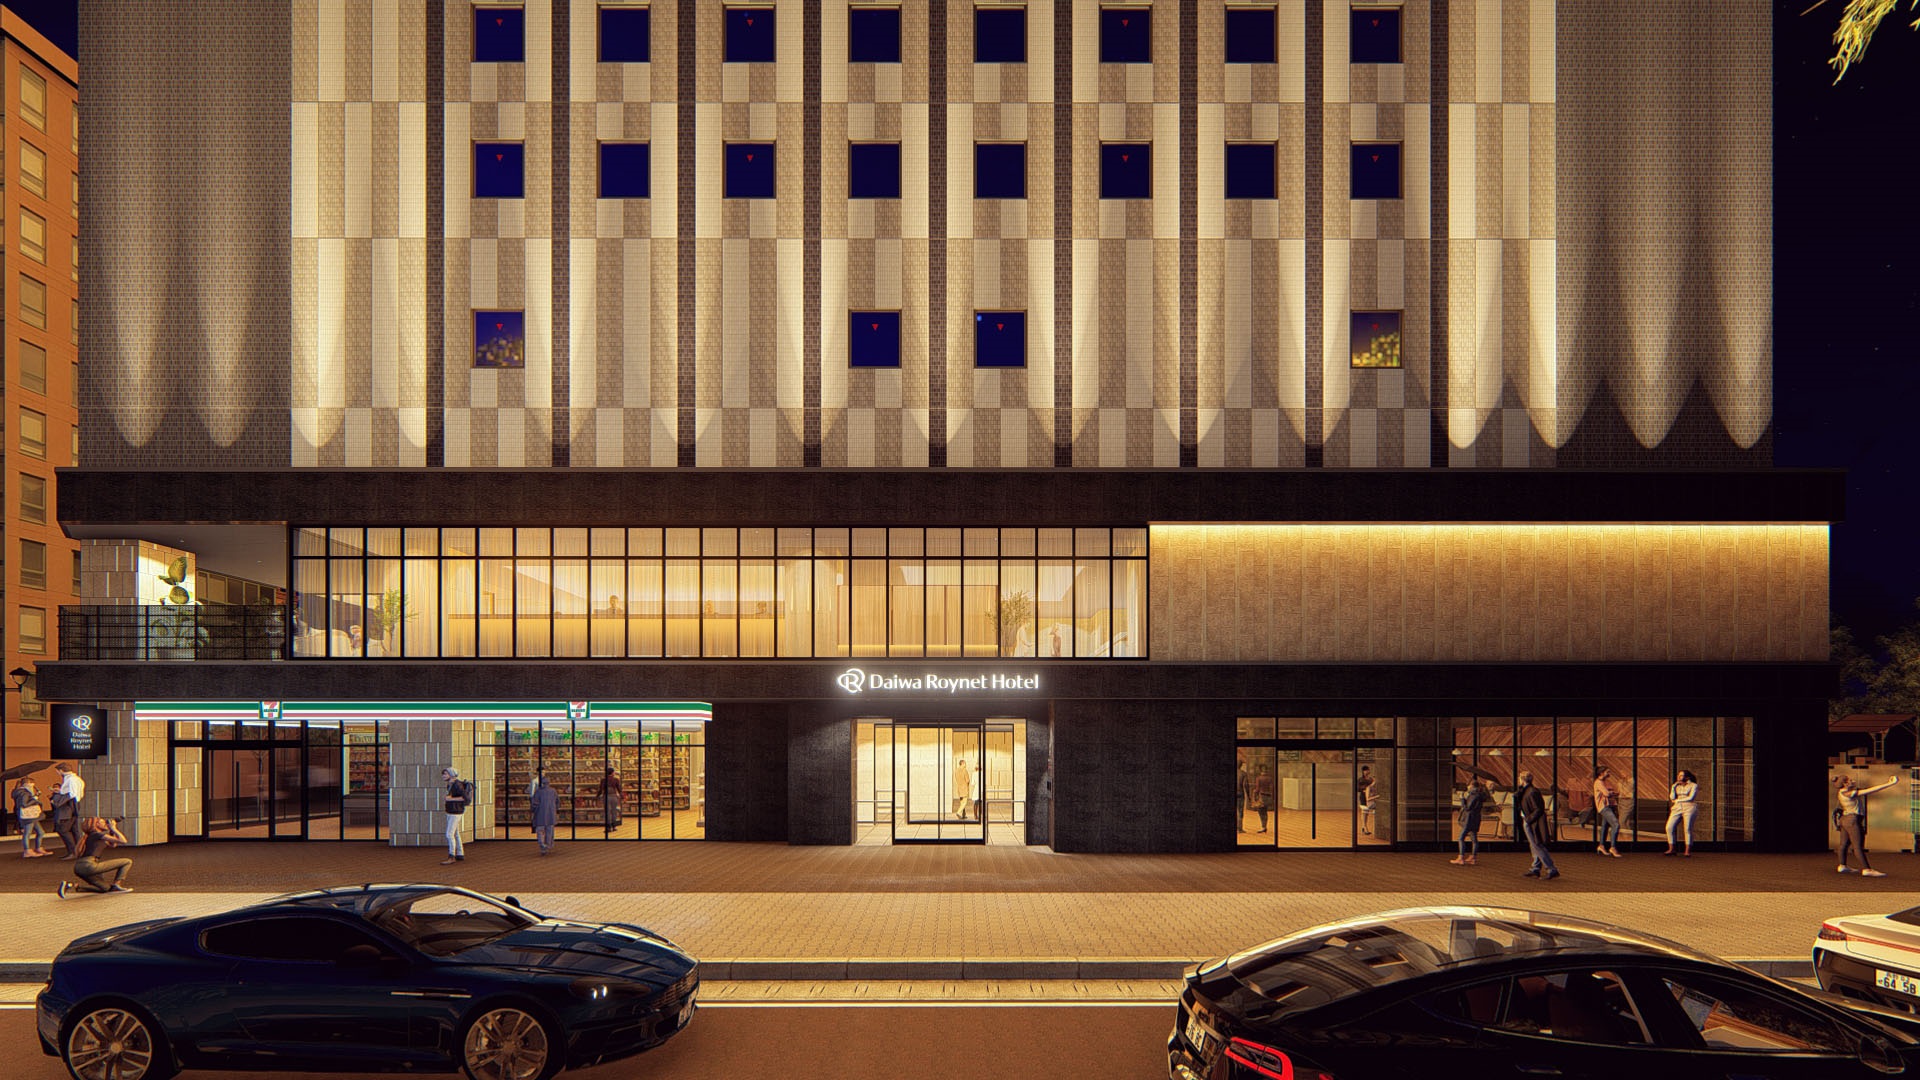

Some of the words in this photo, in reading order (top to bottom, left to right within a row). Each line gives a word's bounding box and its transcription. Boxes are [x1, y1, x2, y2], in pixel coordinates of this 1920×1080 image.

[870, 674, 922, 689] Daiwa
[926, 674, 988, 693] Roynet
[992, 674, 1039, 689] Hotel
